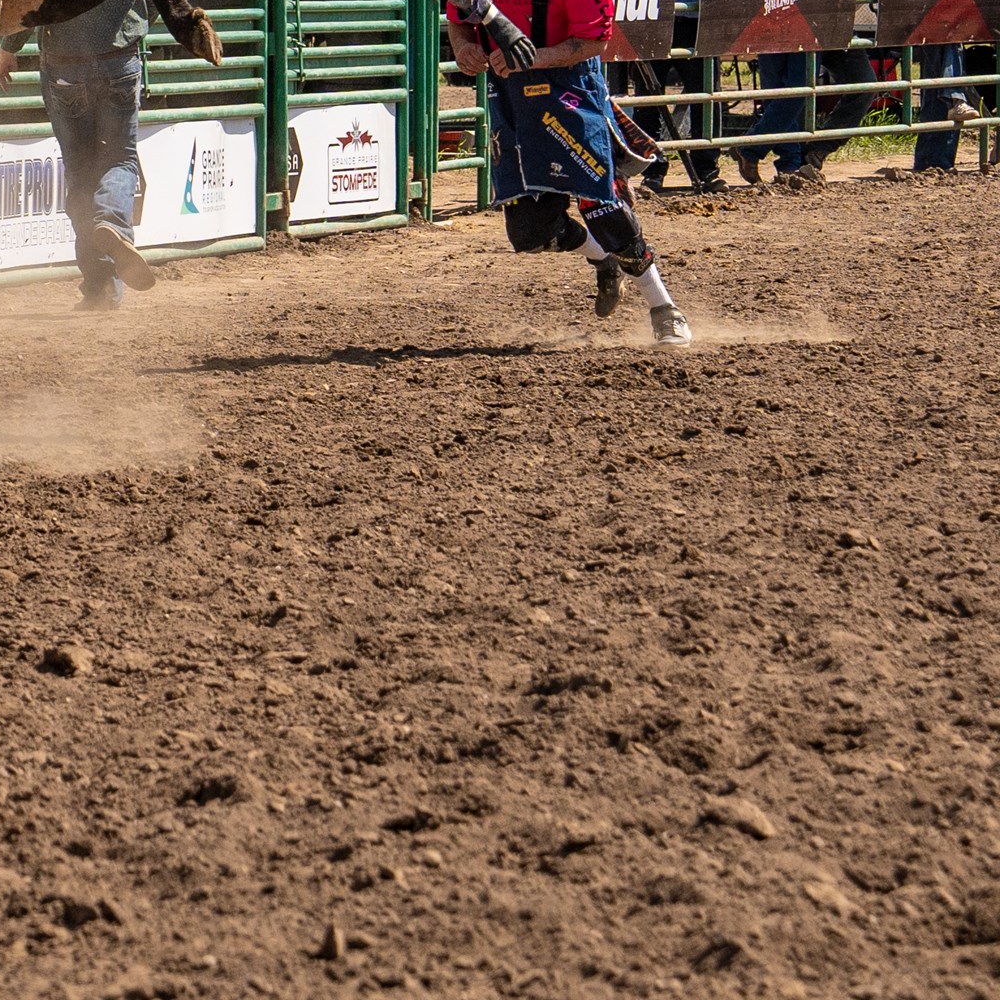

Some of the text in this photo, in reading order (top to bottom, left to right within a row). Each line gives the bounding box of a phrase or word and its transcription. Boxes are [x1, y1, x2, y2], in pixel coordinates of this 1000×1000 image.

[541, 111, 606, 178] VERSATILE
[545, 126, 571, 151] ENERGY
[569, 151, 601, 182] SERVICES
[23, 157, 54, 217] PRO
[332, 172, 377, 192] STOMPEDE
